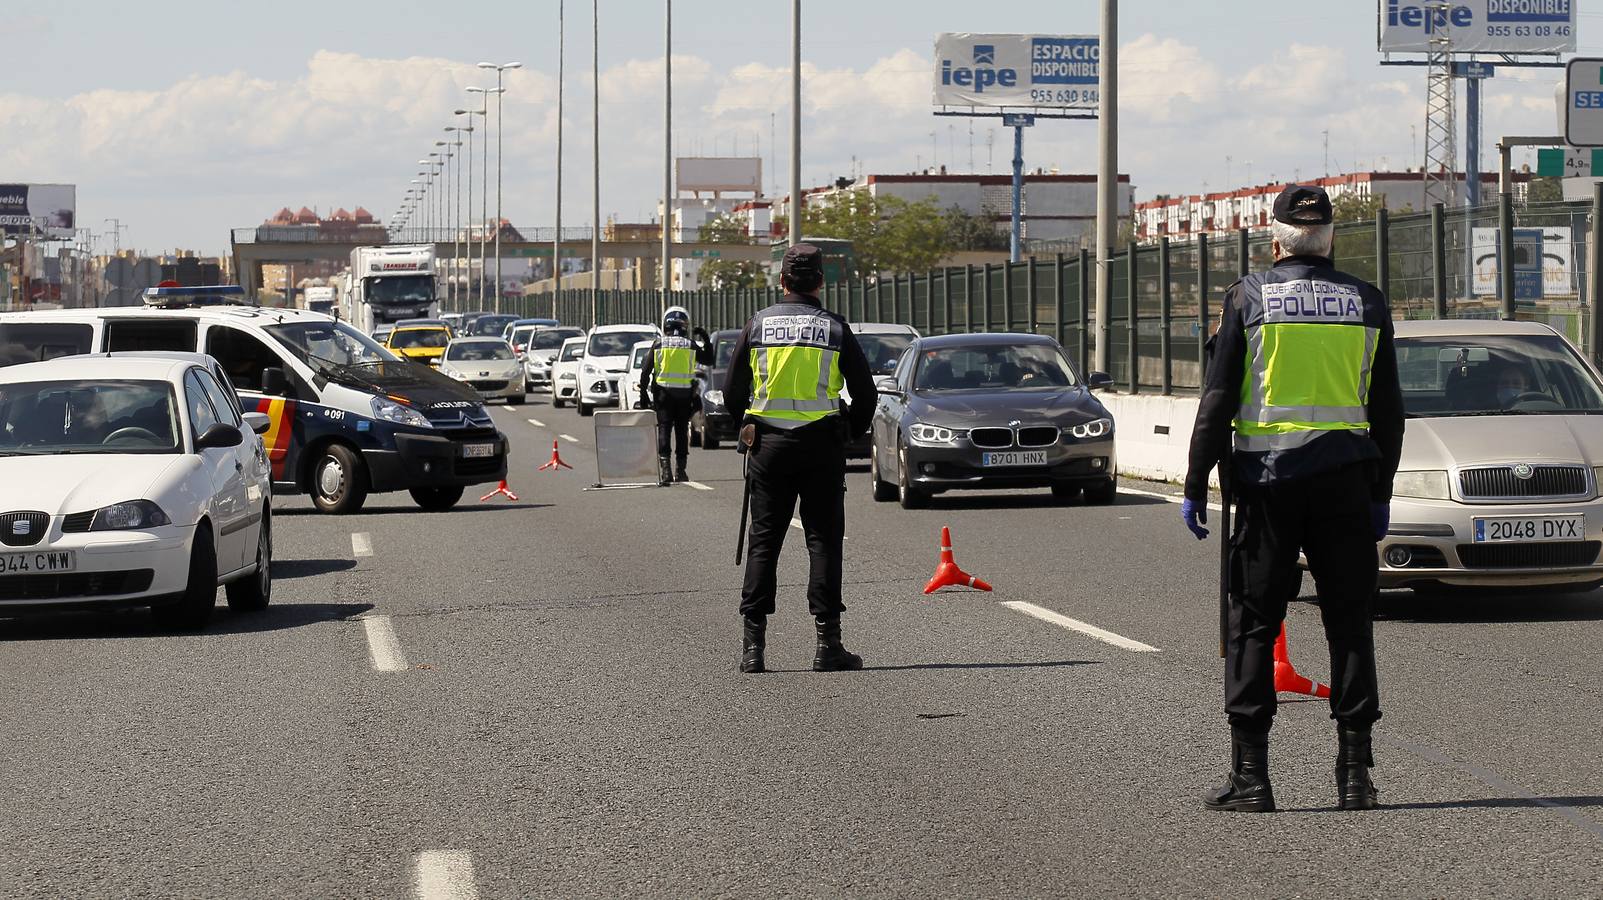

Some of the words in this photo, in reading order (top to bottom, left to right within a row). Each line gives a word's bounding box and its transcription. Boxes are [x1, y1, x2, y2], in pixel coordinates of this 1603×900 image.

[1489, 0, 1568, 14] DISPONIBLE
[1388, 0, 1472, 34] iepe
[1487, 26, 1511, 36] 955
[1515, 26, 1531, 36] 63
[1535, 26, 1551, 36] 08
[1555, 26, 1570, 36] 46
[1032, 44, 1099, 60] ESPACIO
[942, 59, 1017, 93] iepe
[1031, 89, 1052, 103] 955
[1057, 89, 1078, 103] 630
[1576, 92, 1603, 107] SE
[1265, 283, 1302, 295] CUERPO
[1303, 282, 1345, 295] NACIONAL
[1344, 287, 1357, 296] DE
[1266, 296, 1360, 317] POLICIA
[789, 317, 818, 325] NACIONAL
[819, 319, 828, 327] DE
[764, 326, 826, 342] POLICIA
[330, 409, 345, 420] 091
[991, 453, 1018, 465] 8701
[1023, 452, 1044, 464] HNX
[1490, 521, 1536, 539] 2048
[1543, 519, 1577, 538] DYX
[35, 552, 69, 570] CWW
